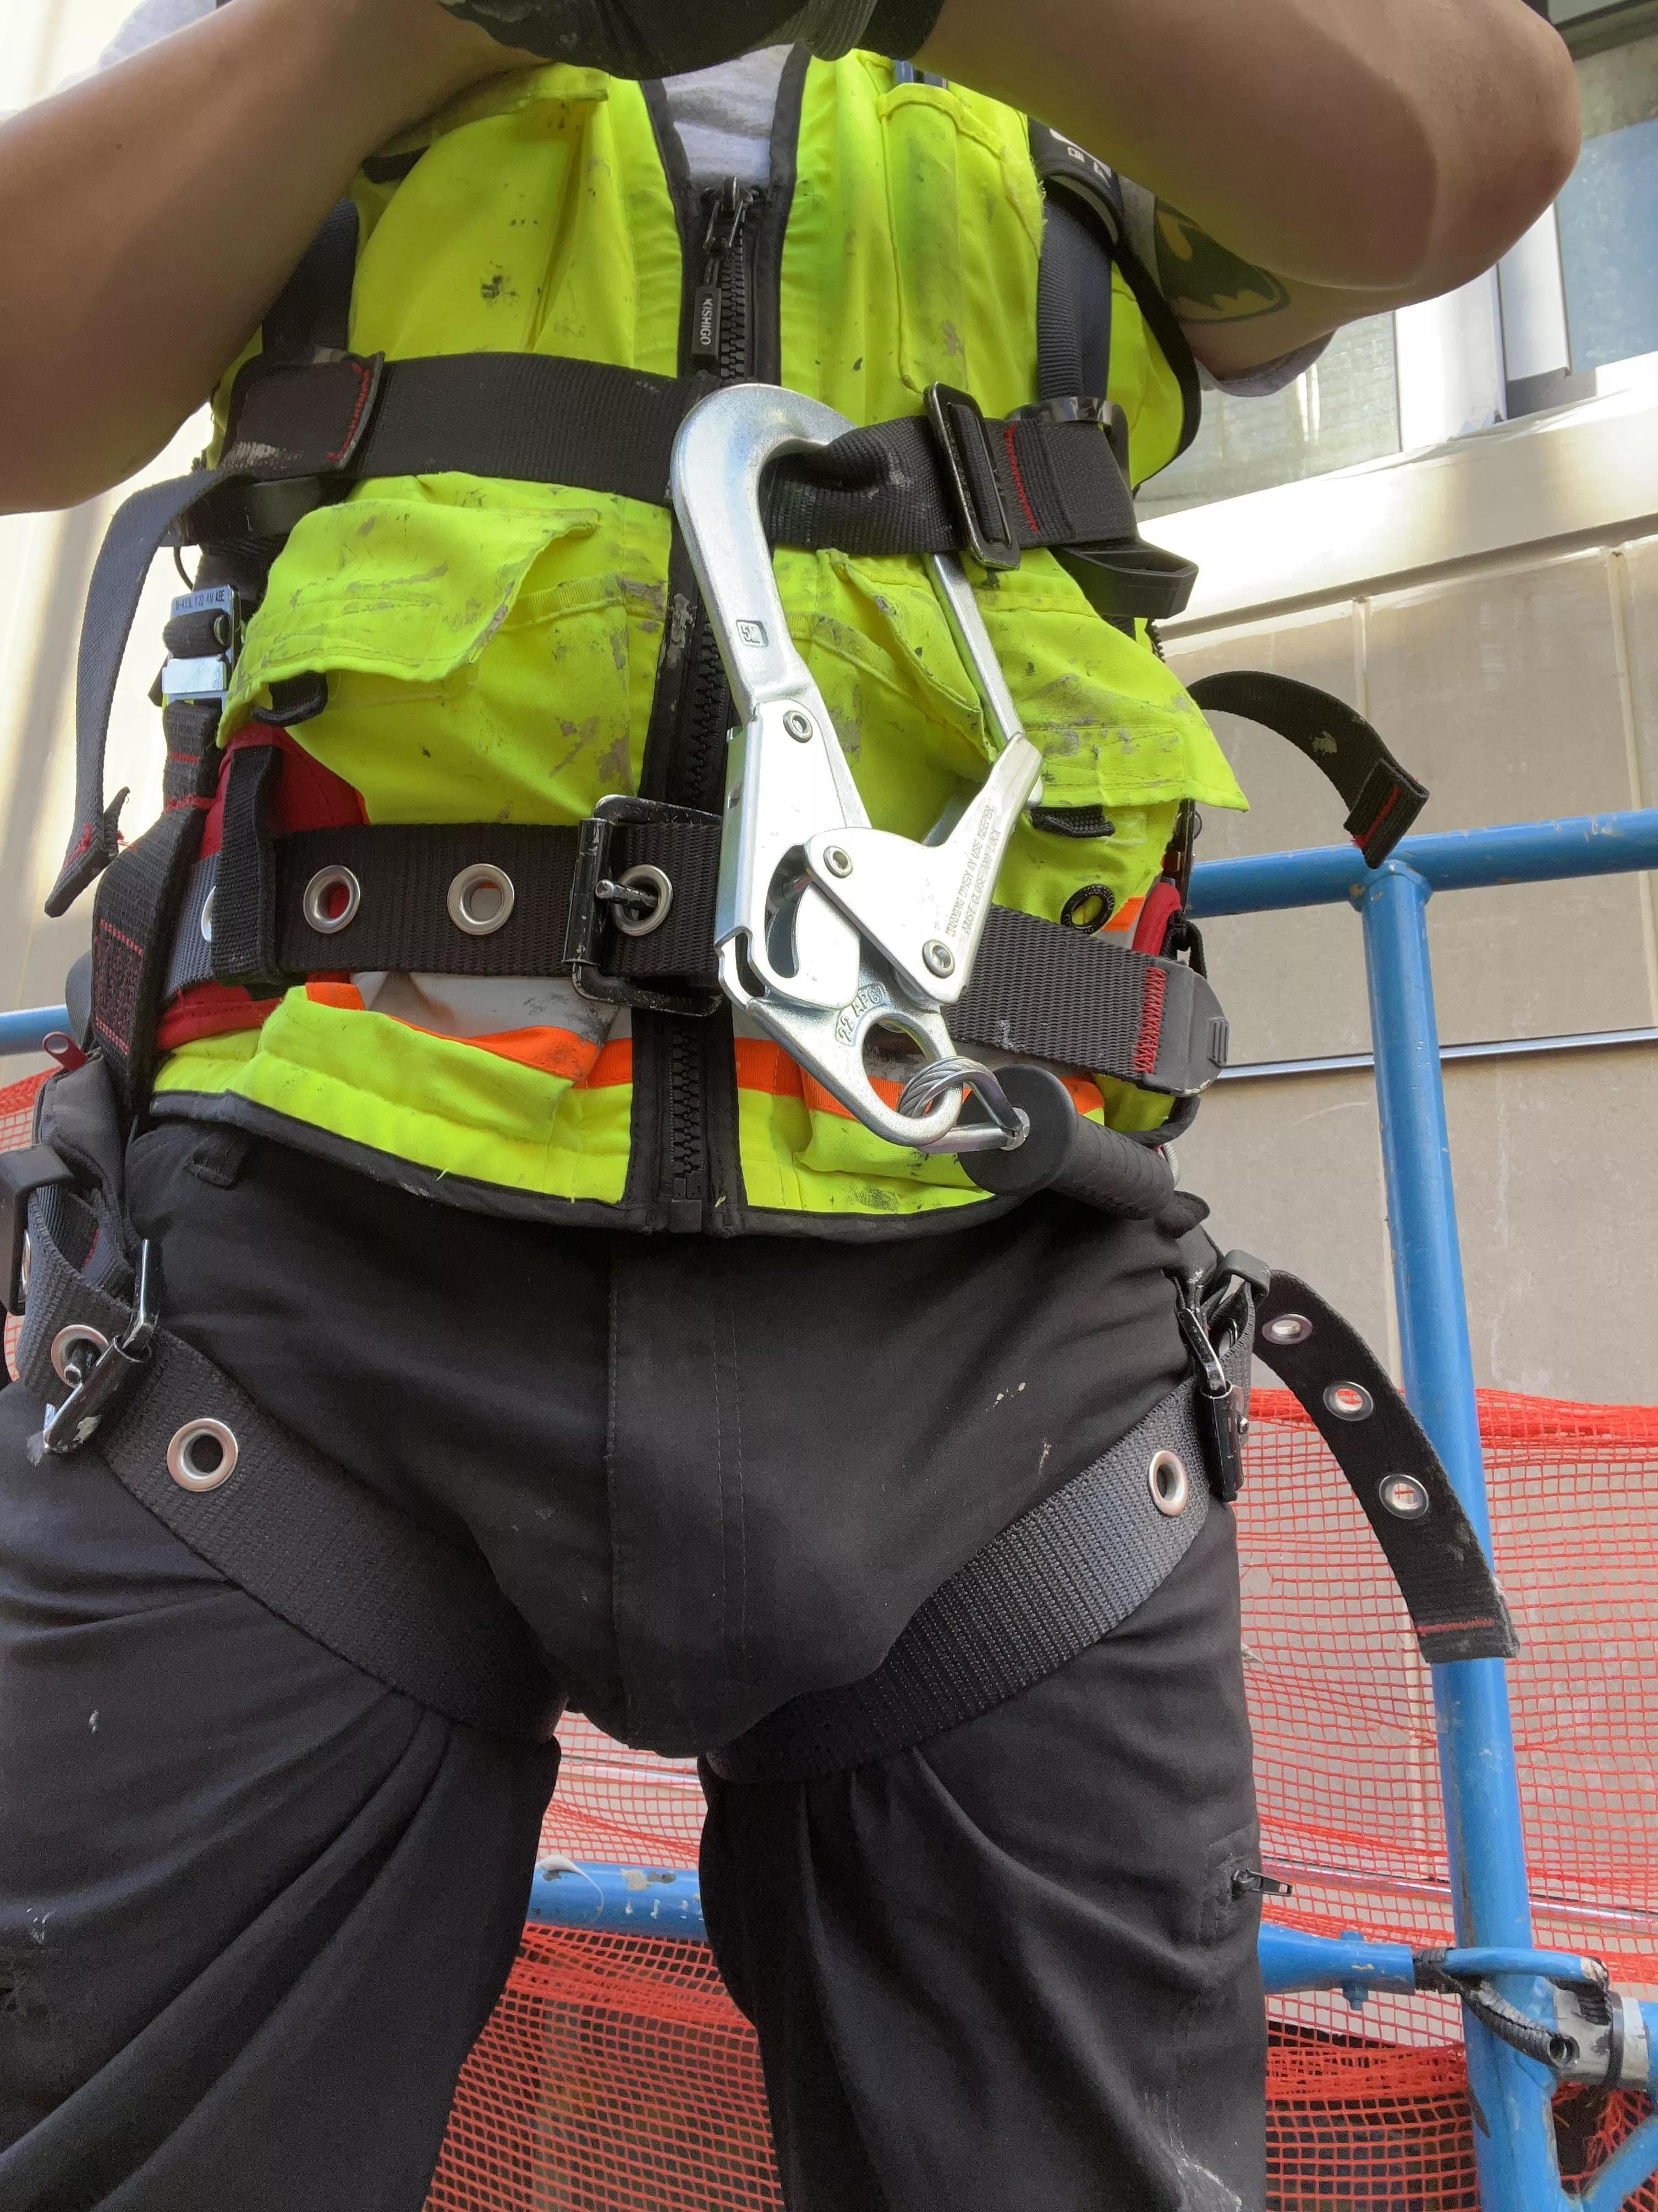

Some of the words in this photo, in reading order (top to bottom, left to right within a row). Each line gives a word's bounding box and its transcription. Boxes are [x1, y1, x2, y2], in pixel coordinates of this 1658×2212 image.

[700, 298, 713, 345] KISHIGO
[195, 594, 204, 607] Y22
[215, 589, 224, 602] ABE
[971, 840, 983, 859] USE
